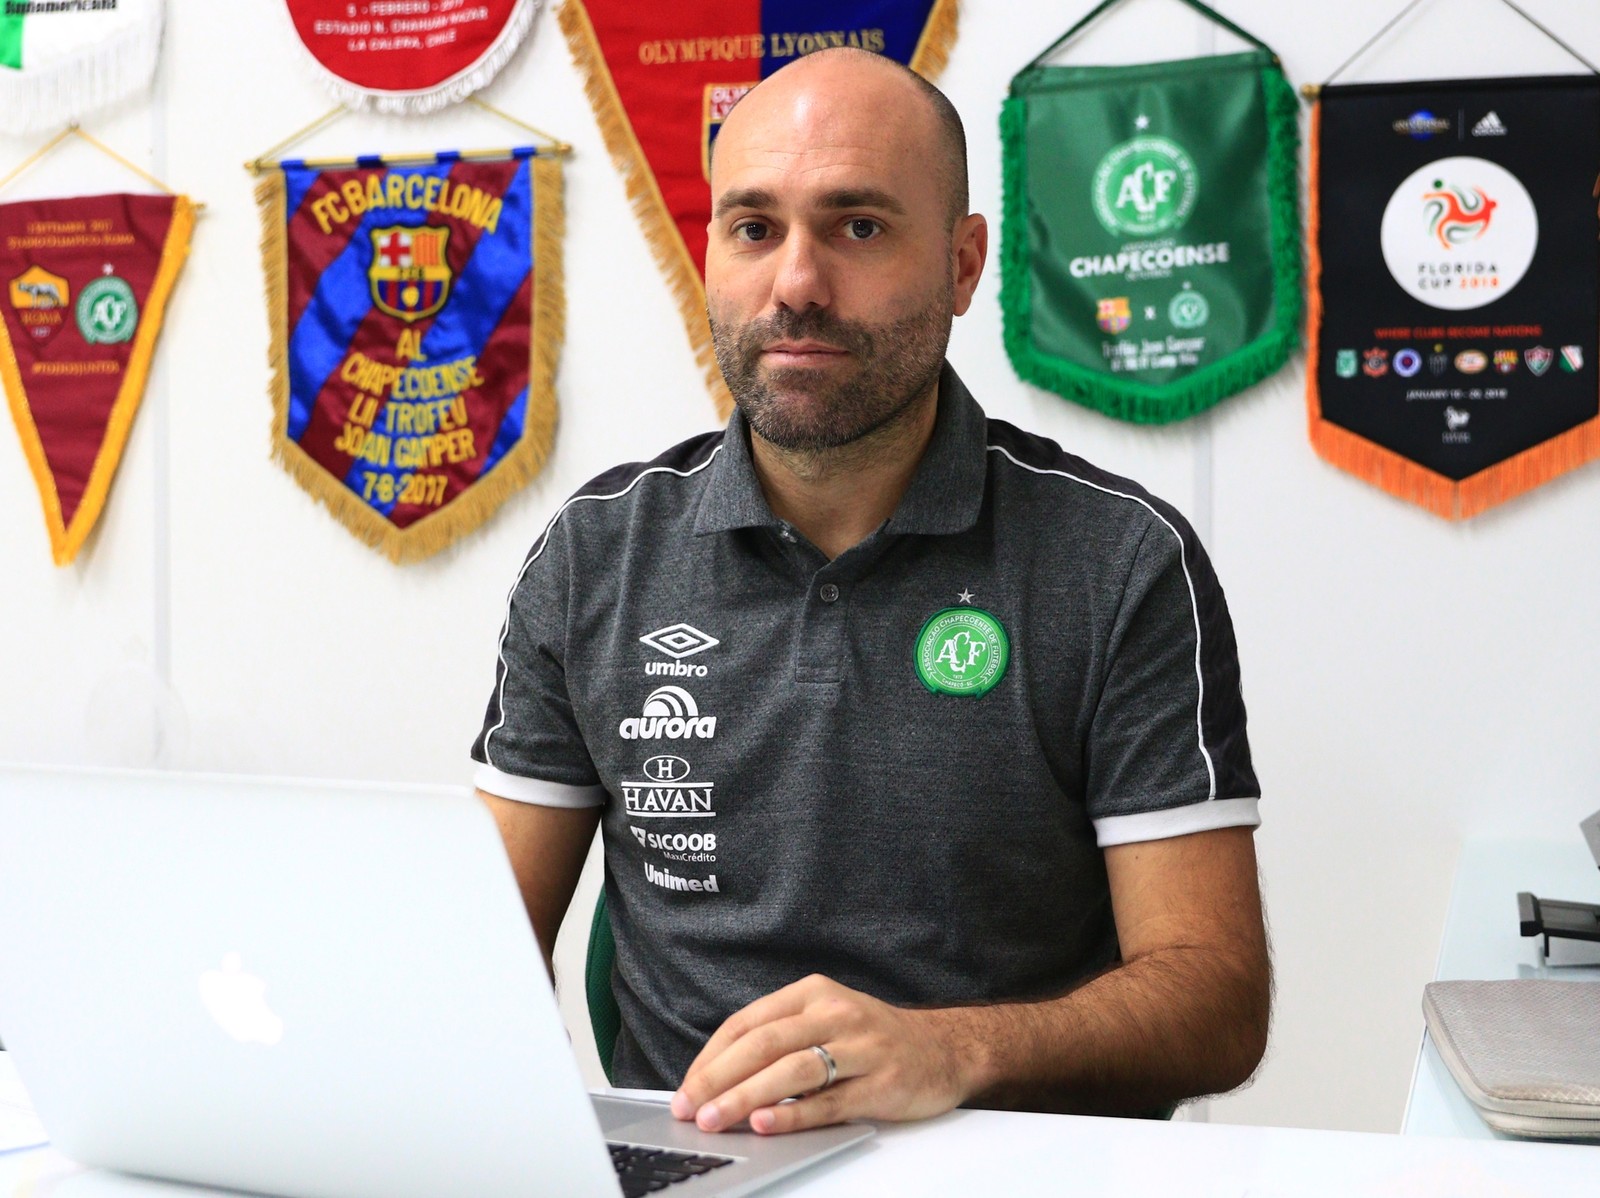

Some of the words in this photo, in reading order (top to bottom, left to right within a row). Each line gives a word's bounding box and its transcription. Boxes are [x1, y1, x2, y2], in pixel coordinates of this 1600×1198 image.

[314, 20, 371, 34] ESTADIO
[349, 39, 367, 51] LA
[639, 33, 765, 65] OLYMPIQUE
[770, 29, 885, 58] LYONNAIS
[311, 192, 349, 235] FC
[342, 174, 503, 234] BARCELONA
[1069, 242, 1231, 279] CHAPECOENSE
[1418, 262, 1499, 276] FLORIDA
[1418, 278, 1454, 291] CUP
[396, 328, 428, 361] AL
[341, 352, 484, 399] CHAPECOENSE
[1405, 389, 1449, 401] JANUARY
[385, 395, 468, 434] TROFEU
[334, 421, 392, 467] JOAN
[394, 427, 477, 469] GAMPER
[939, 615, 992, 635] CHAPECOENSE
[988, 632, 998, 644] DE
[645, 660, 708, 677] umbro
[986, 645, 1000, 677] FUTEBOL
[619, 716, 717, 739] aurora
[657, 759, 674, 778] H
[622, 787, 713, 812] HAVAN
[647, 833, 717, 851] SICOOB
[644, 861, 720, 893] Unimed
